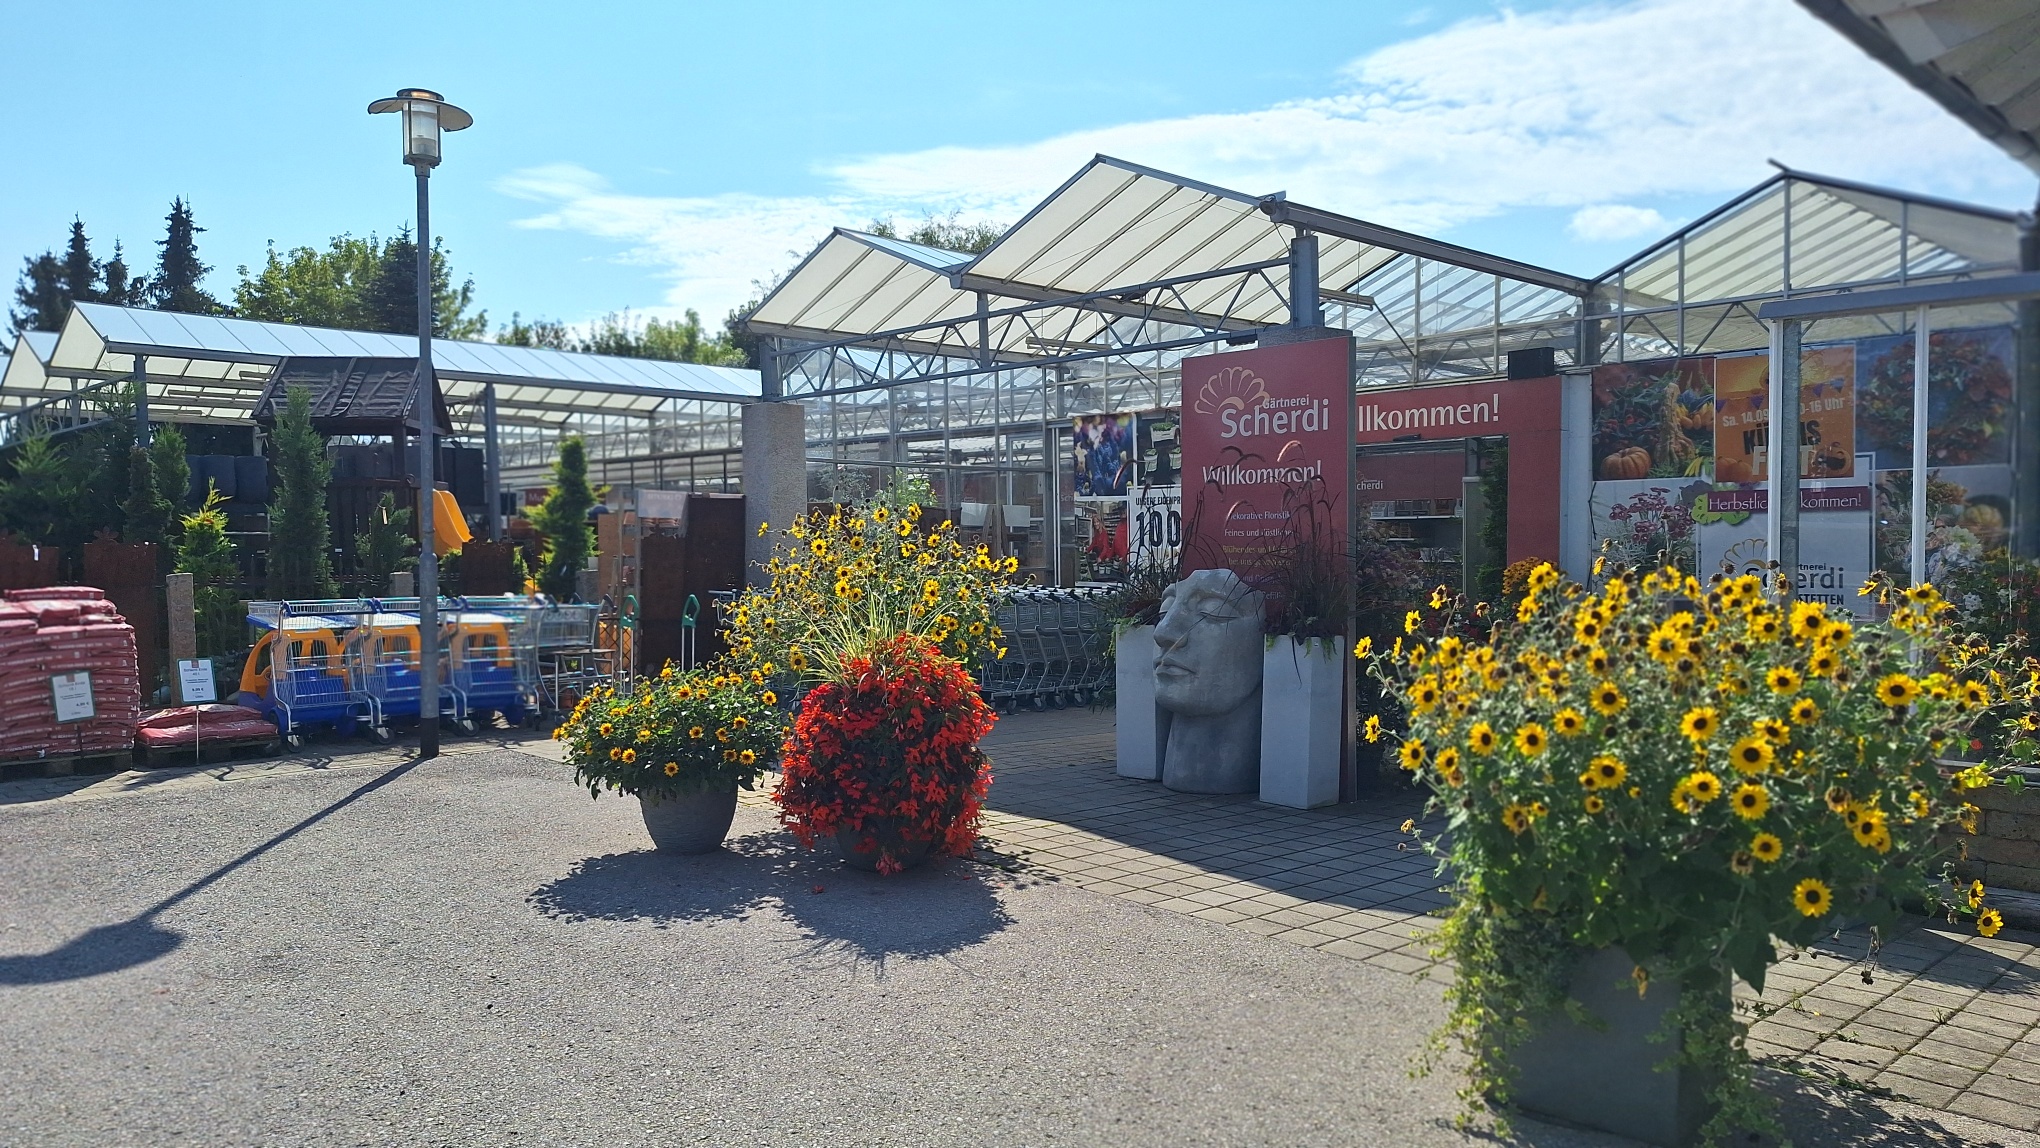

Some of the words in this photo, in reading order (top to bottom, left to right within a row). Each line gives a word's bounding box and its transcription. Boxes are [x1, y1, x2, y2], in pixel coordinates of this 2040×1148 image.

[1263, 394, 1310, 409] Gärtnerei
[1358, 393, 1499, 432] llkommen!
[1722, 415, 1739, 427] Sa.
[1741, 409, 1769, 424] 14.09
[1800, 399, 1822, 415] 0-16
[1825, 397, 1845, 411] Uhr
[1220, 398, 1329, 438] Scherdi
[1743, 420, 1821, 455] KÜIS
[1752, 445, 1814, 476] FT
[1202, 460, 1322, 486] Willkommen!
[1356, 480, 1384, 491] cherdi
[1709, 492, 1768, 510] Herbstlic
[1800, 491, 1862, 508] kommen!
[1229, 511, 1263, 520] ekorative
[1264, 510, 1290, 520] Floristik
[1135, 510, 1181, 547] 100
[1224, 528, 1245, 537] Feines
[1246, 528, 1259, 537] und
[1799, 563, 1827, 571] tnerei
[1799, 594, 1844, 605] STETTEN
